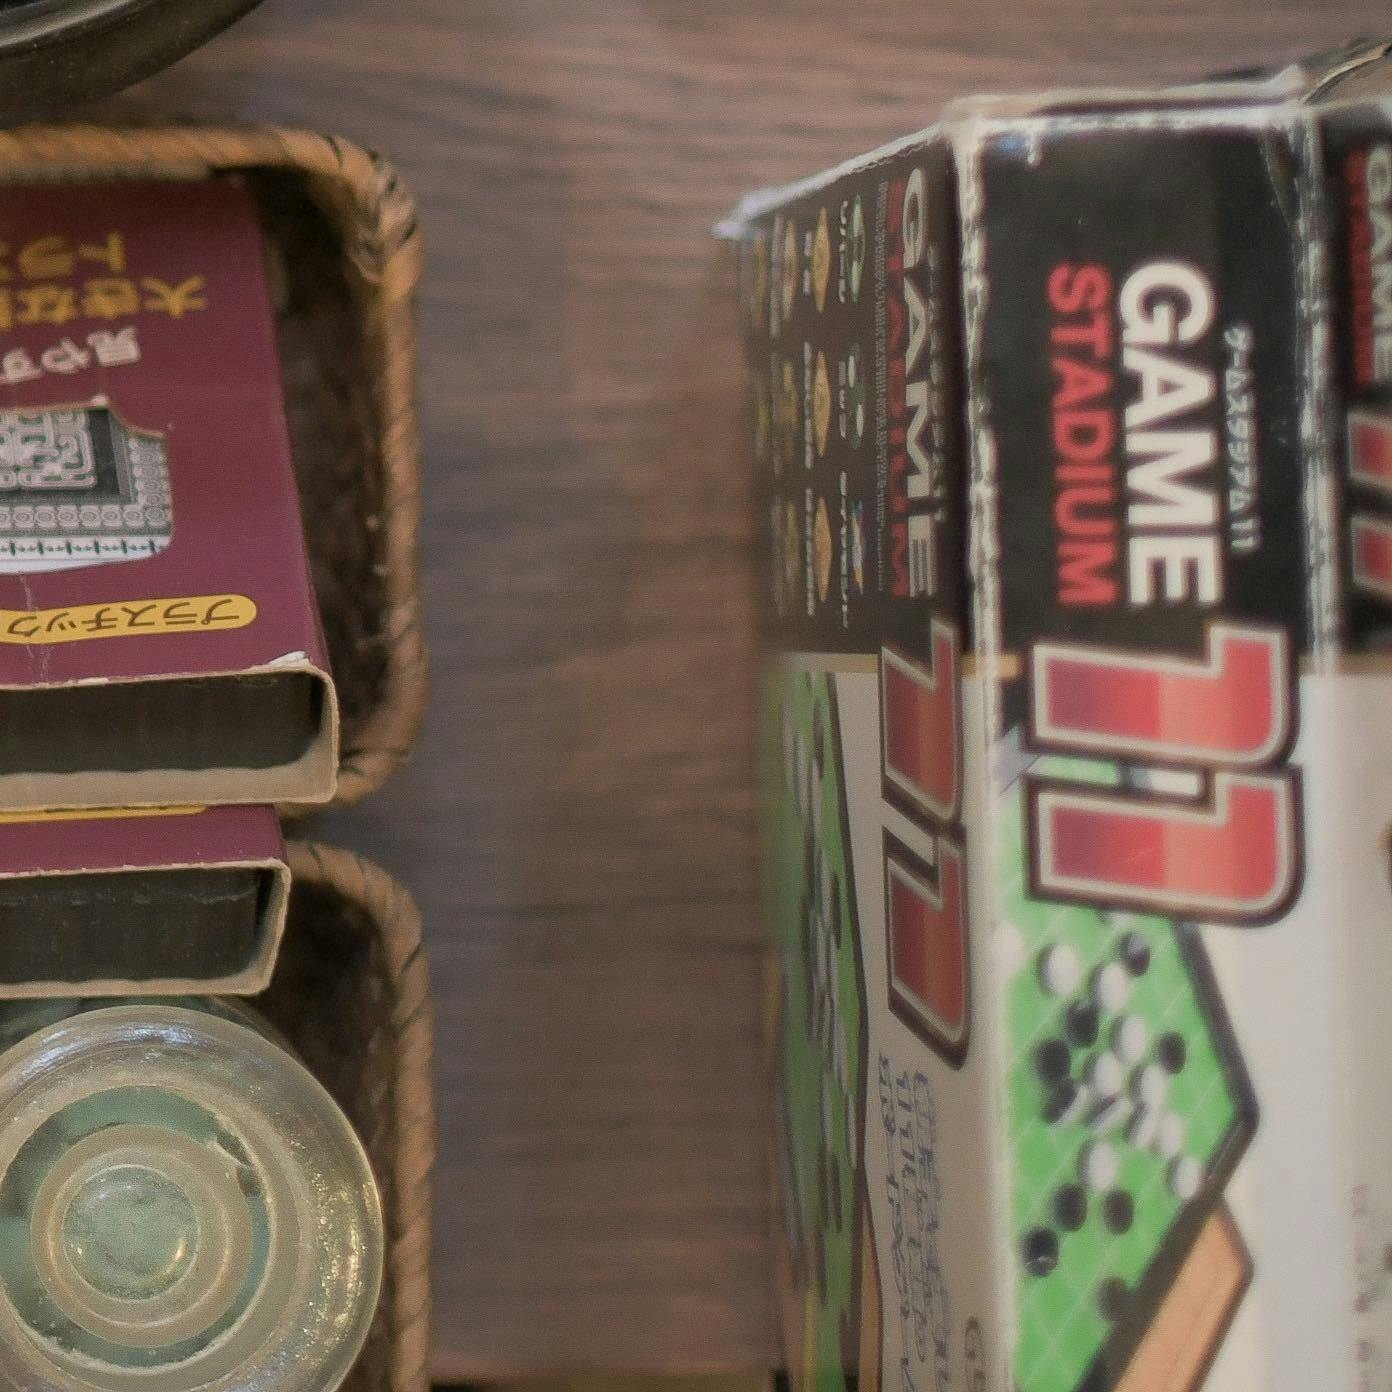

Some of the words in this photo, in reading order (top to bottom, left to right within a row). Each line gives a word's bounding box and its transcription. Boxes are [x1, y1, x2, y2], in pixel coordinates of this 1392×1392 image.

[903, 168, 936, 598] GAME
[1047, 263, 1118, 606] STADIUM
[1120, 260, 1221, 605] GAME
[1028, 622, 1304, 925] 11
